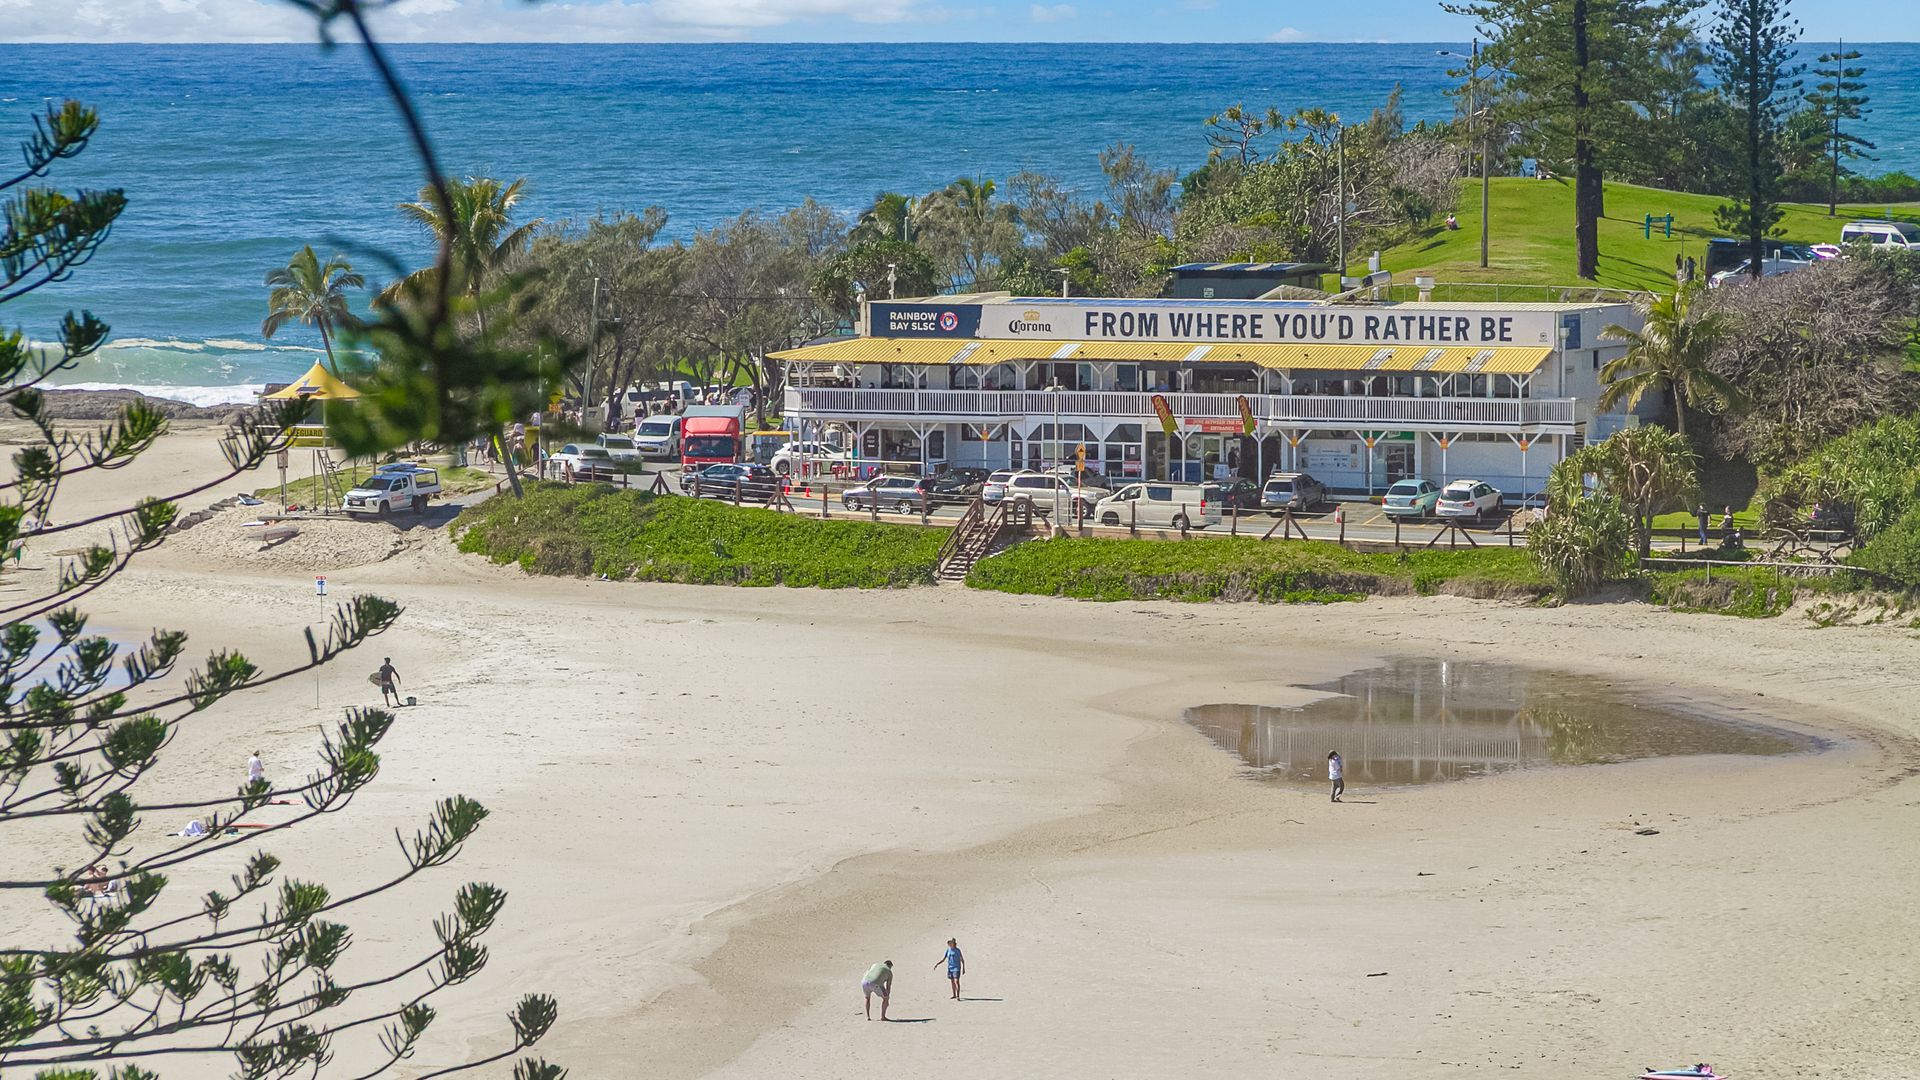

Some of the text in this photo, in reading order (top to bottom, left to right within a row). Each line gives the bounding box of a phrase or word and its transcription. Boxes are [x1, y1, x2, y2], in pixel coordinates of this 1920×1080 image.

[889, 311, 938, 320] RAINBOW
[889, 321, 936, 331] BAY SLSC
[1008, 319, 1051, 335] Corona
[1085, 312, 1513, 342] FROM WHERE YOU'D RATHER BE
